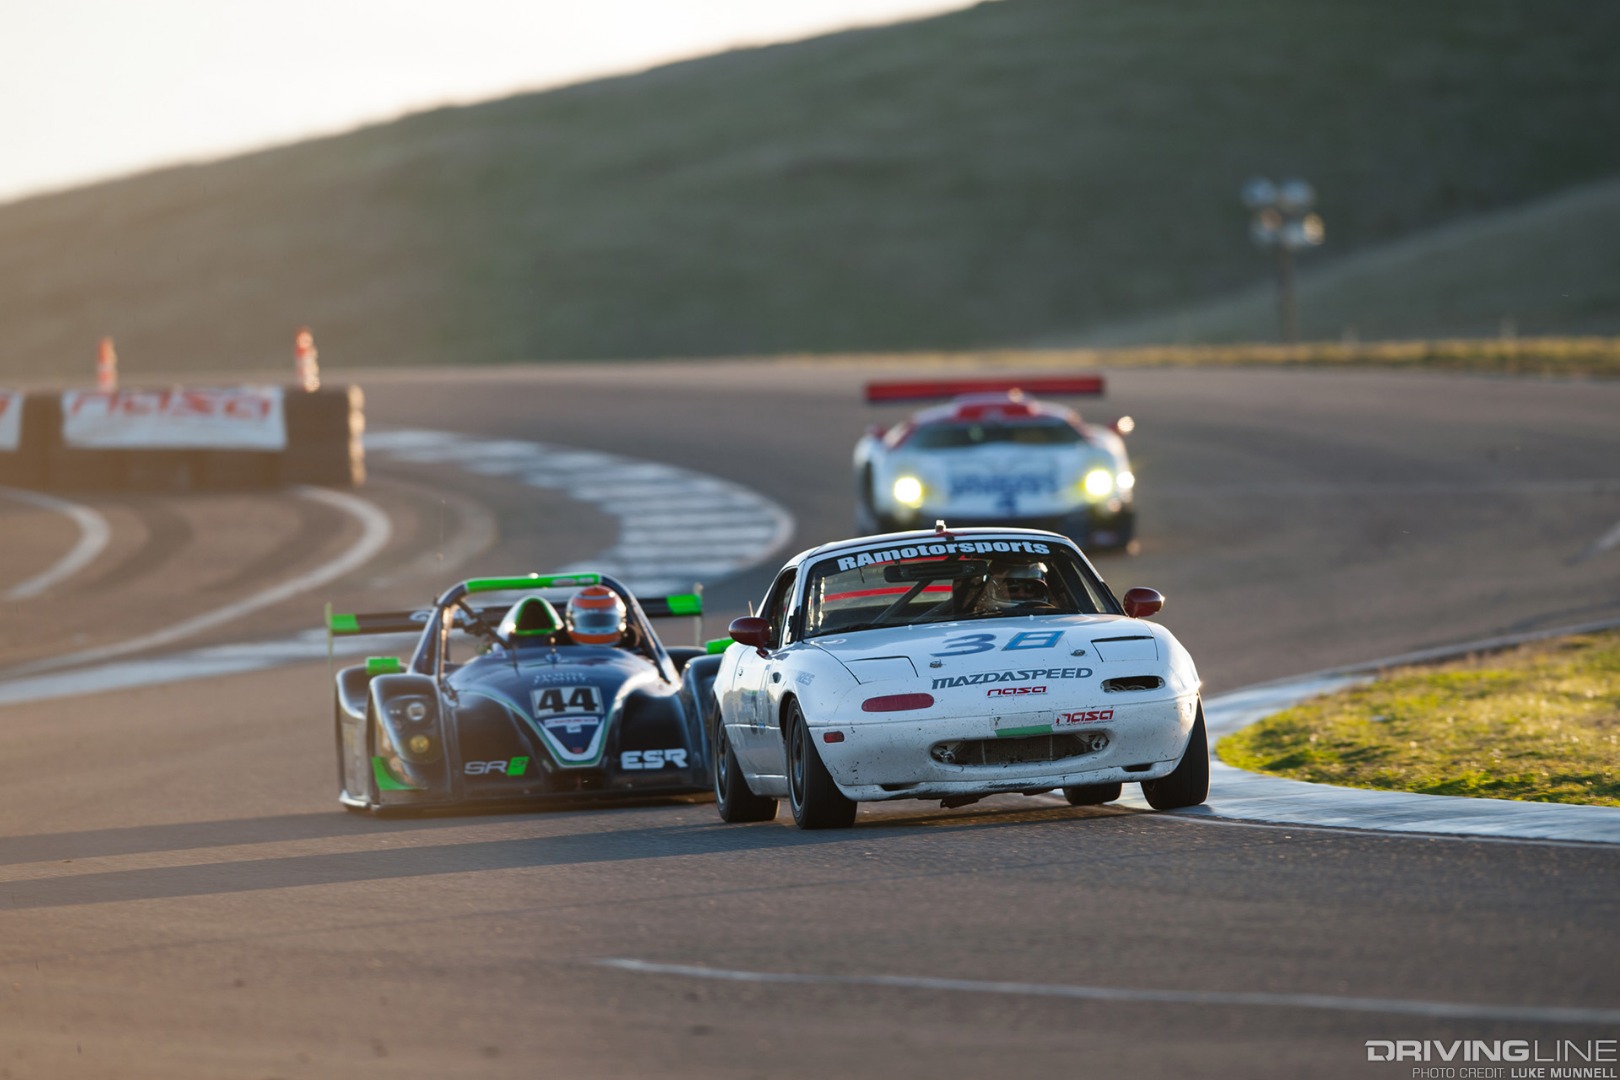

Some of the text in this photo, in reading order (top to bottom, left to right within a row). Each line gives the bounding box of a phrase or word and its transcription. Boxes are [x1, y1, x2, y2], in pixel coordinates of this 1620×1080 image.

[837, 541, 1050, 572] RAmotorsports
[930, 630, 1066, 657] 38
[931, 667, 1093, 690] MAZDASPEED
[538, 687, 599, 713] 44
[987, 686, 1047, 696] nasa
[620, 748, 689, 770] ESR
